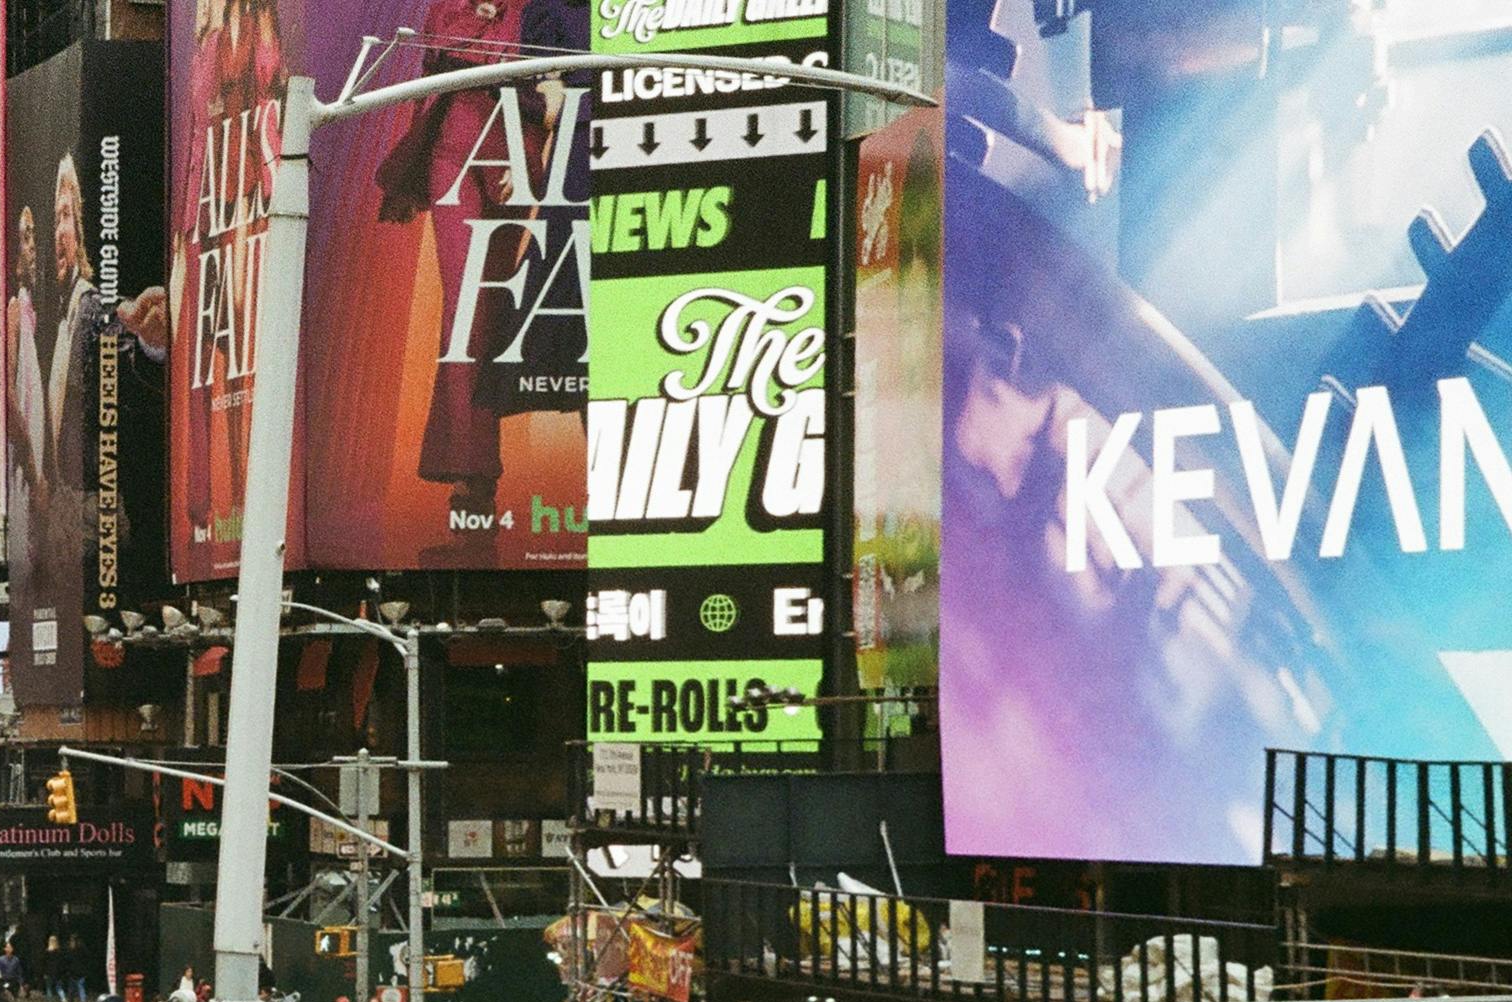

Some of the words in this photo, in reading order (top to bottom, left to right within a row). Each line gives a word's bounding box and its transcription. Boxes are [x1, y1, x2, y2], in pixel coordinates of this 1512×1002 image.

[657, 286, 826, 415] The
[98, 431, 118, 509] HAVE
[449, 510, 495, 530] Nov
[499, 510, 514, 530] 4
[98, 512, 118, 588] EYES
[98, 592, 117, 609] 3
[78, 821, 136, 845] Dolls
